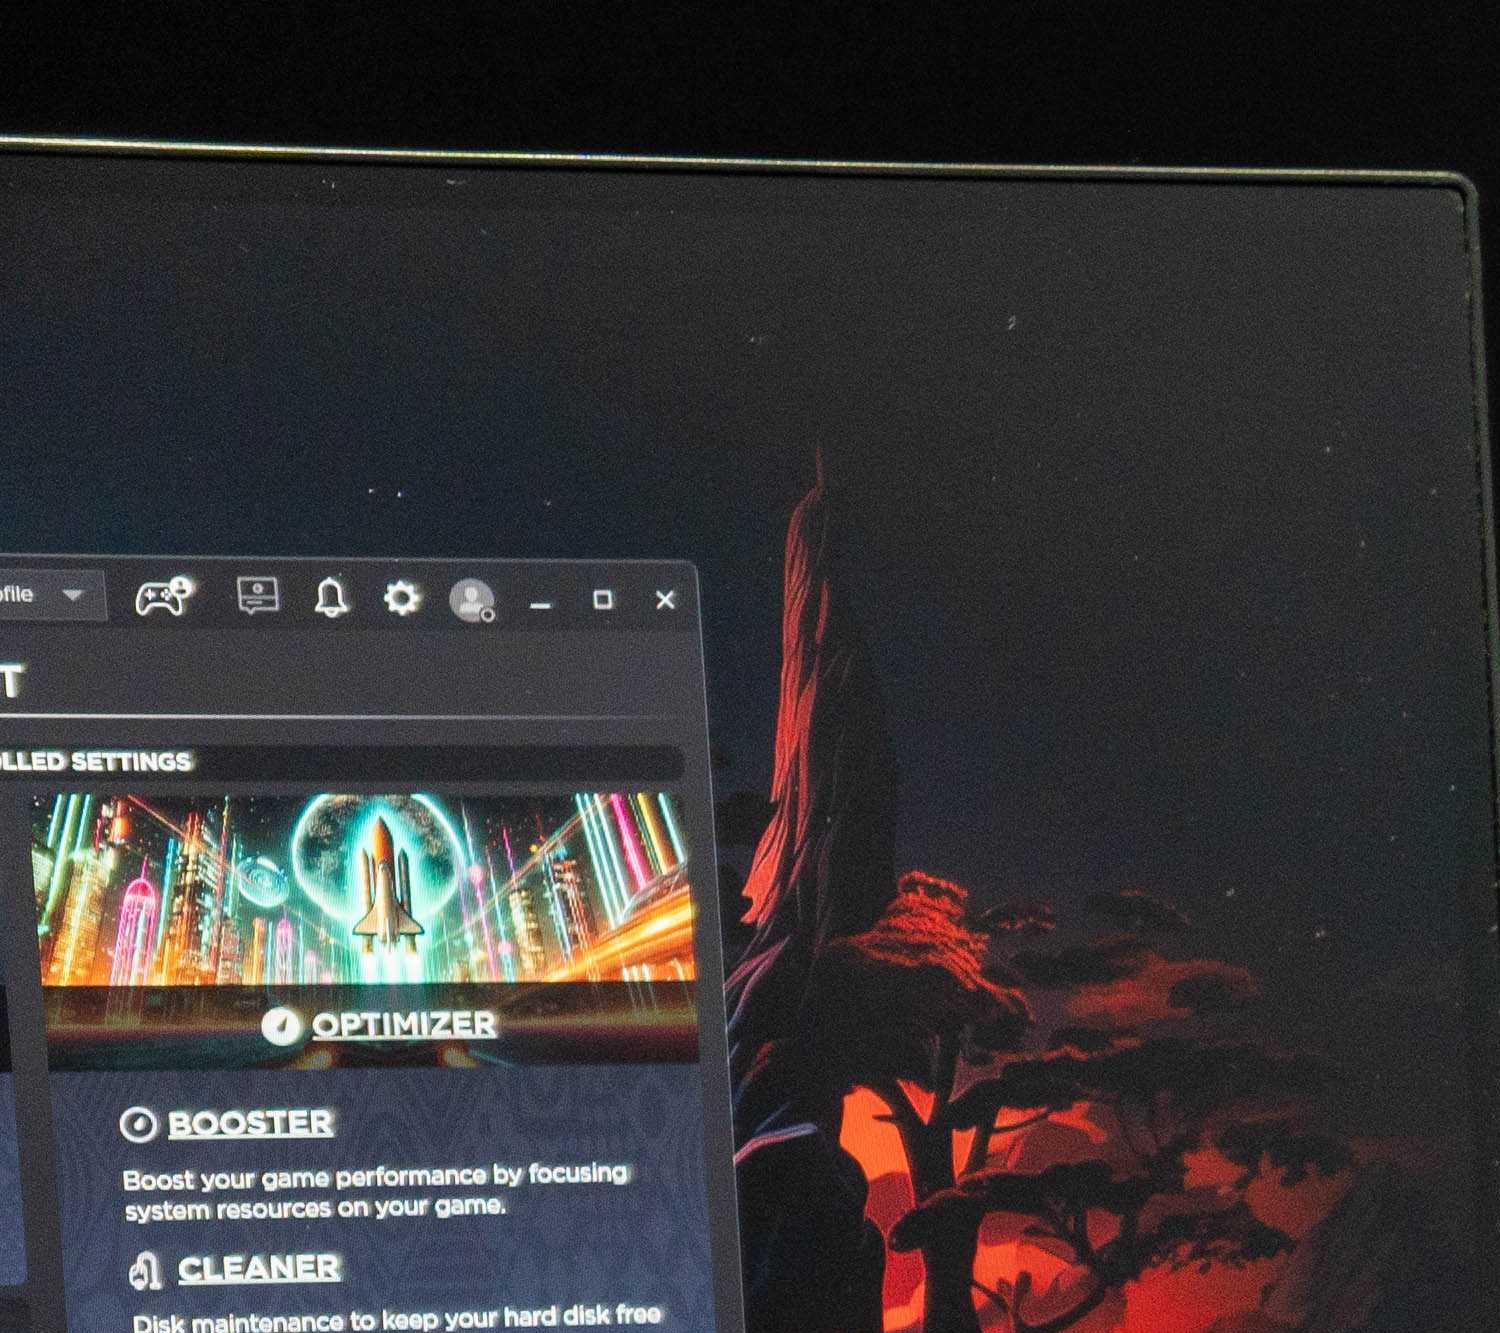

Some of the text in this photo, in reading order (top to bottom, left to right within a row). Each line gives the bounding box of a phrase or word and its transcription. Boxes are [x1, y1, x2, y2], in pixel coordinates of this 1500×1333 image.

[0, 584, 34, 603] file
[0, 751, 193, 772] LLED SETTINGS
[312, 1010, 497, 1039] OPTIMIZER
[168, 1109, 335, 1138] BOOSTER
[123, 1162, 629, 1192] Boost your game performance by focusing
[126, 1197, 507, 1224] system resources on your game.
[178, 1254, 342, 1283] CLEANER
[351, 1311, 376, 1331] to
[382, 1308, 439, 1332] keep
[445, 1311, 498, 1331] your
[504, 1306, 557, 1327] hard
[563, 1304, 610, 1326] disk
[616, 1303, 662, 1324] free
